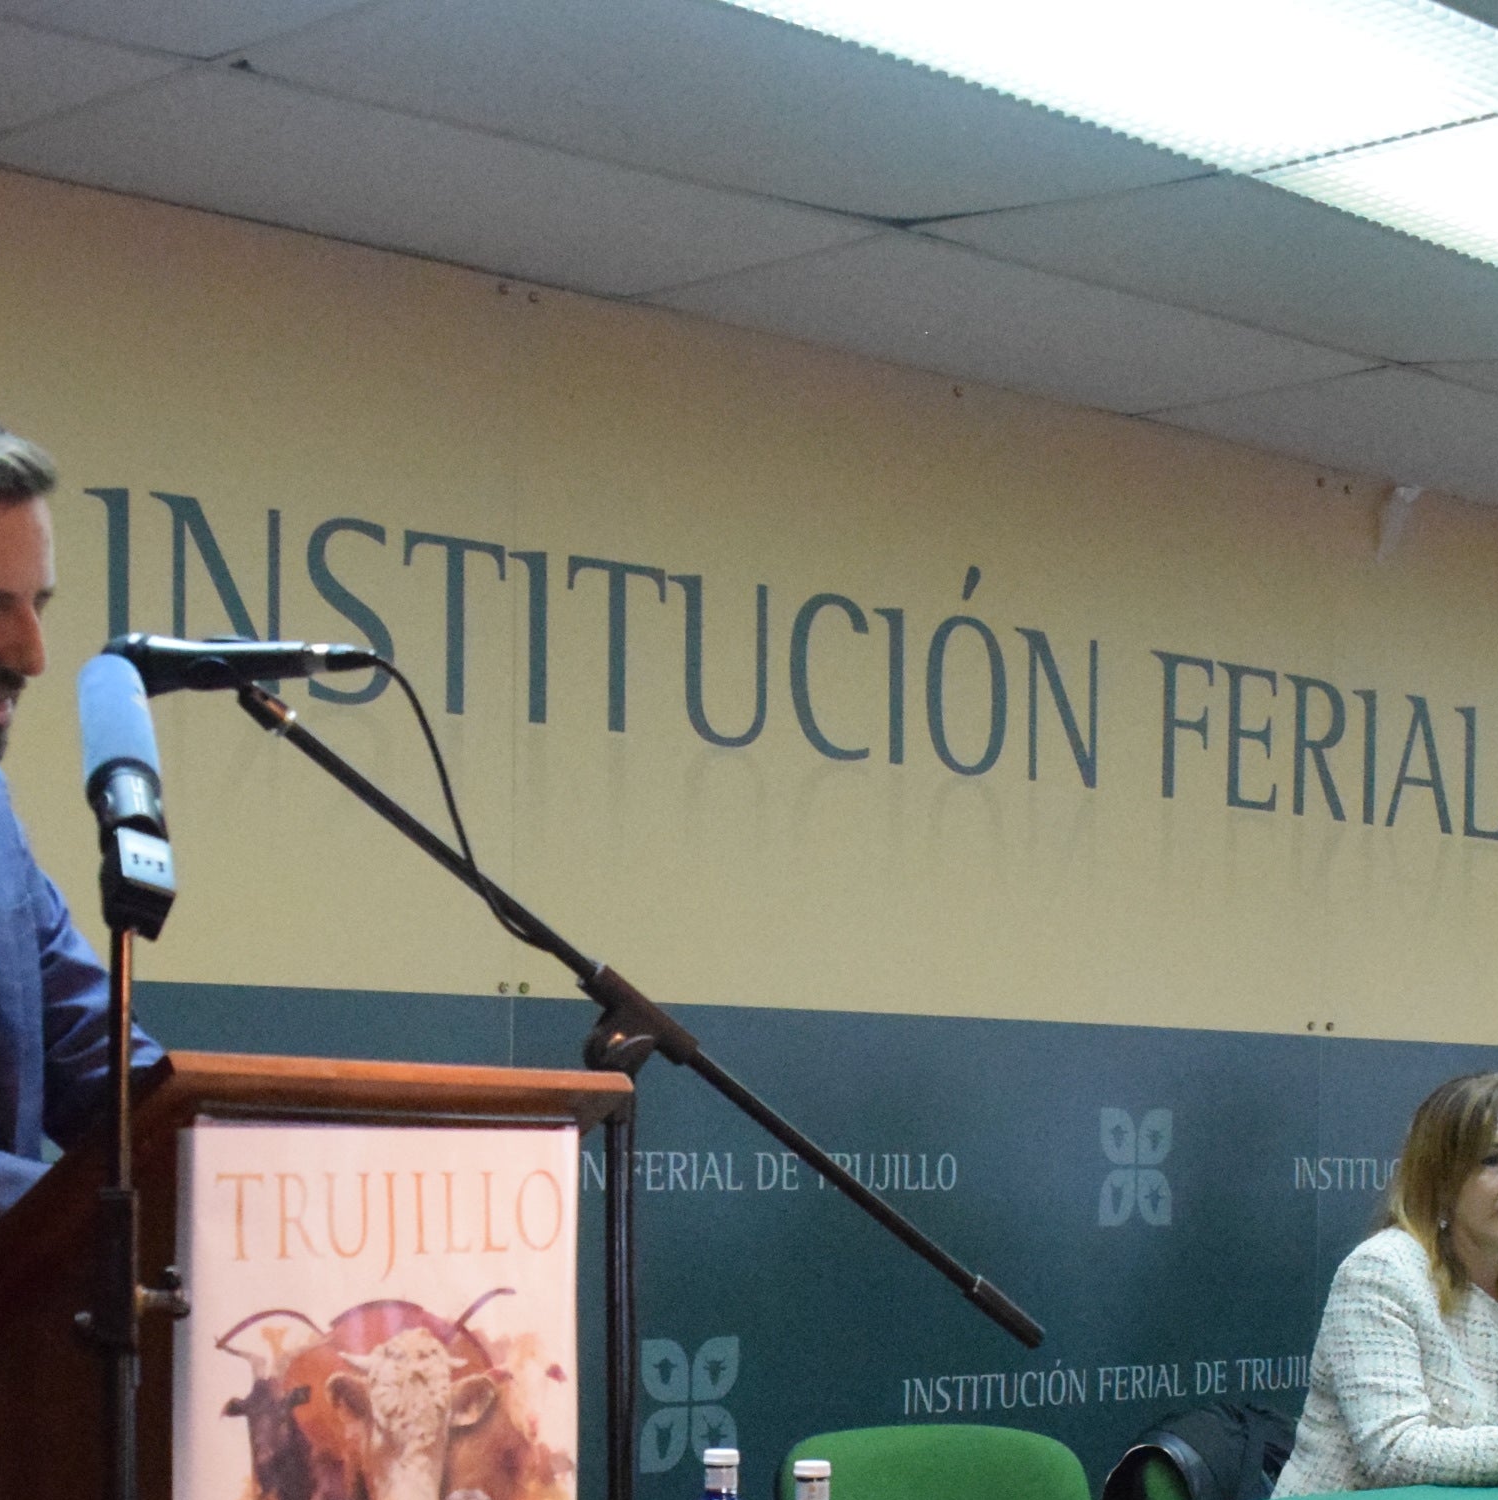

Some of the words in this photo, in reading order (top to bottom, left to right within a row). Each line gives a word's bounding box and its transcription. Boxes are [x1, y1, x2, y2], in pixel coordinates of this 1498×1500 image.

[84, 487, 1099, 789] INSTITUCIÓN
[755, 1152, 799, 1191] DE
[215, 1168, 564, 1281] TRUJILLO
[902, 1359, 1087, 1416] INSTITUCIÓN
[1098, 1363, 1188, 1402] FERIAL
[1195, 1360, 1228, 1396] DE
